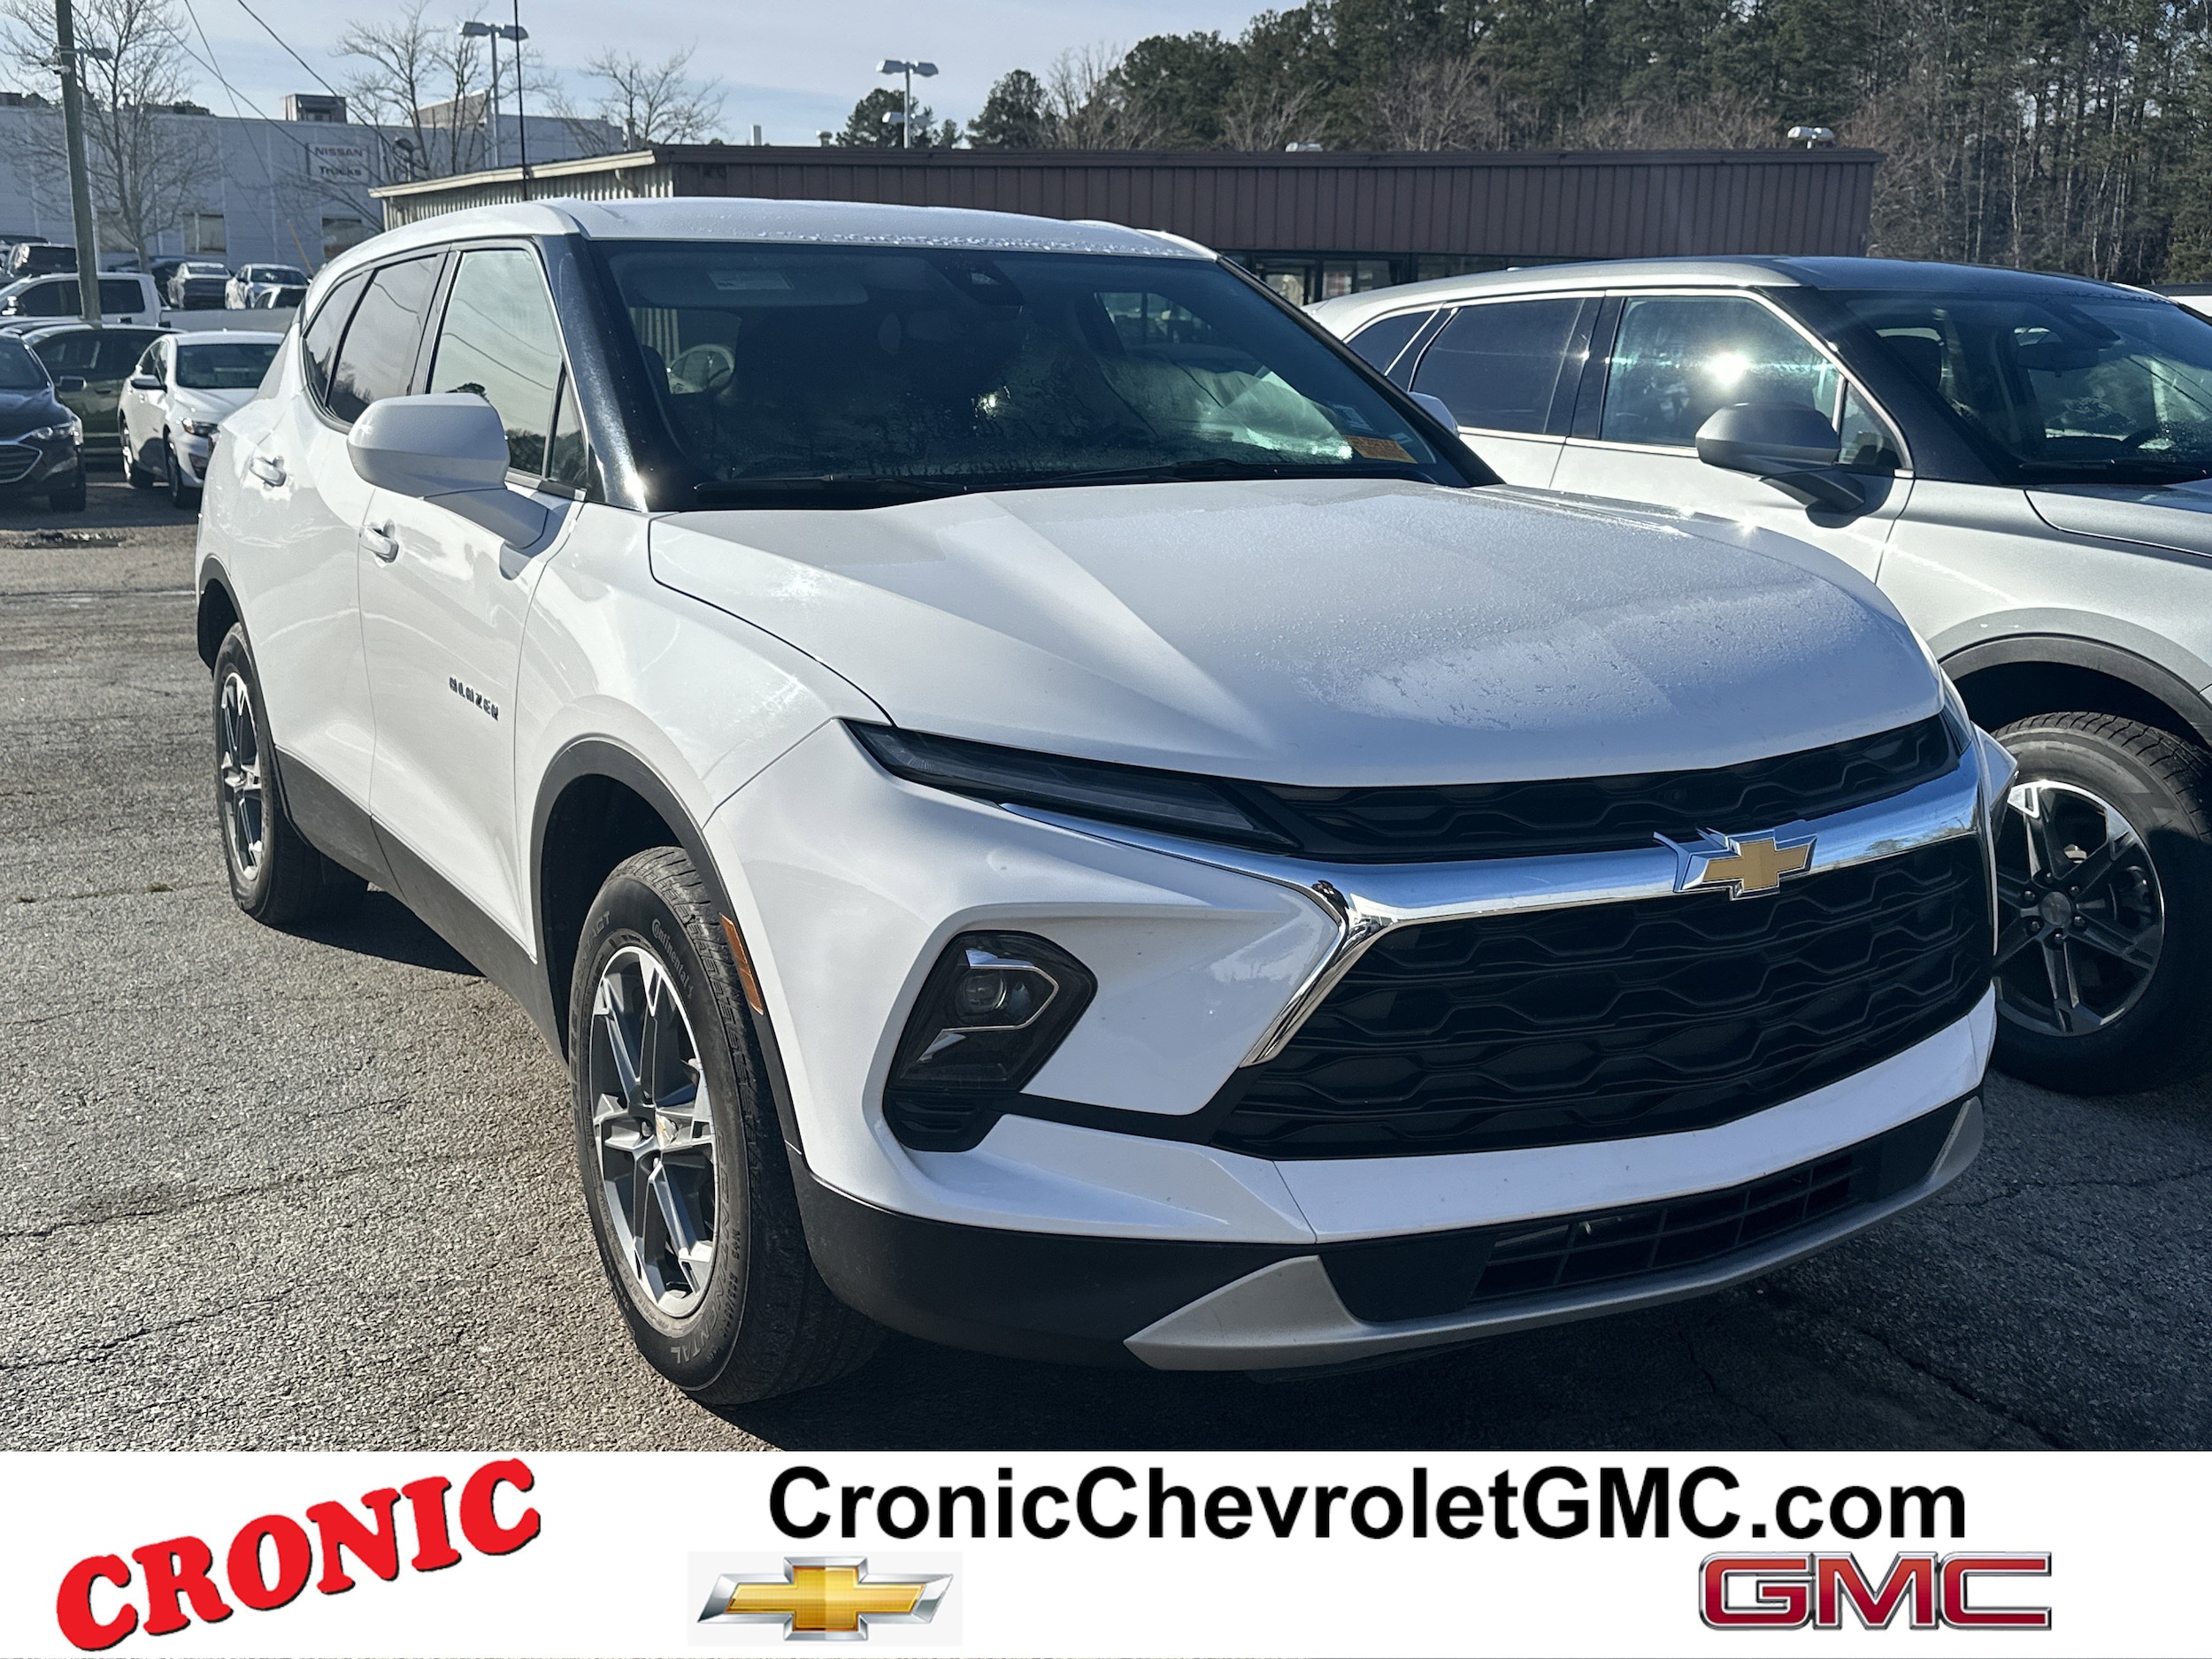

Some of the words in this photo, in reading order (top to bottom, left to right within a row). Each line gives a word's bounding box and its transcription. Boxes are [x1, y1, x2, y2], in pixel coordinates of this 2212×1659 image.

[315, 147, 363, 157] NISSAN
[449, 677, 499, 722] BLAZER
[651, 918, 690, 989] Continental
